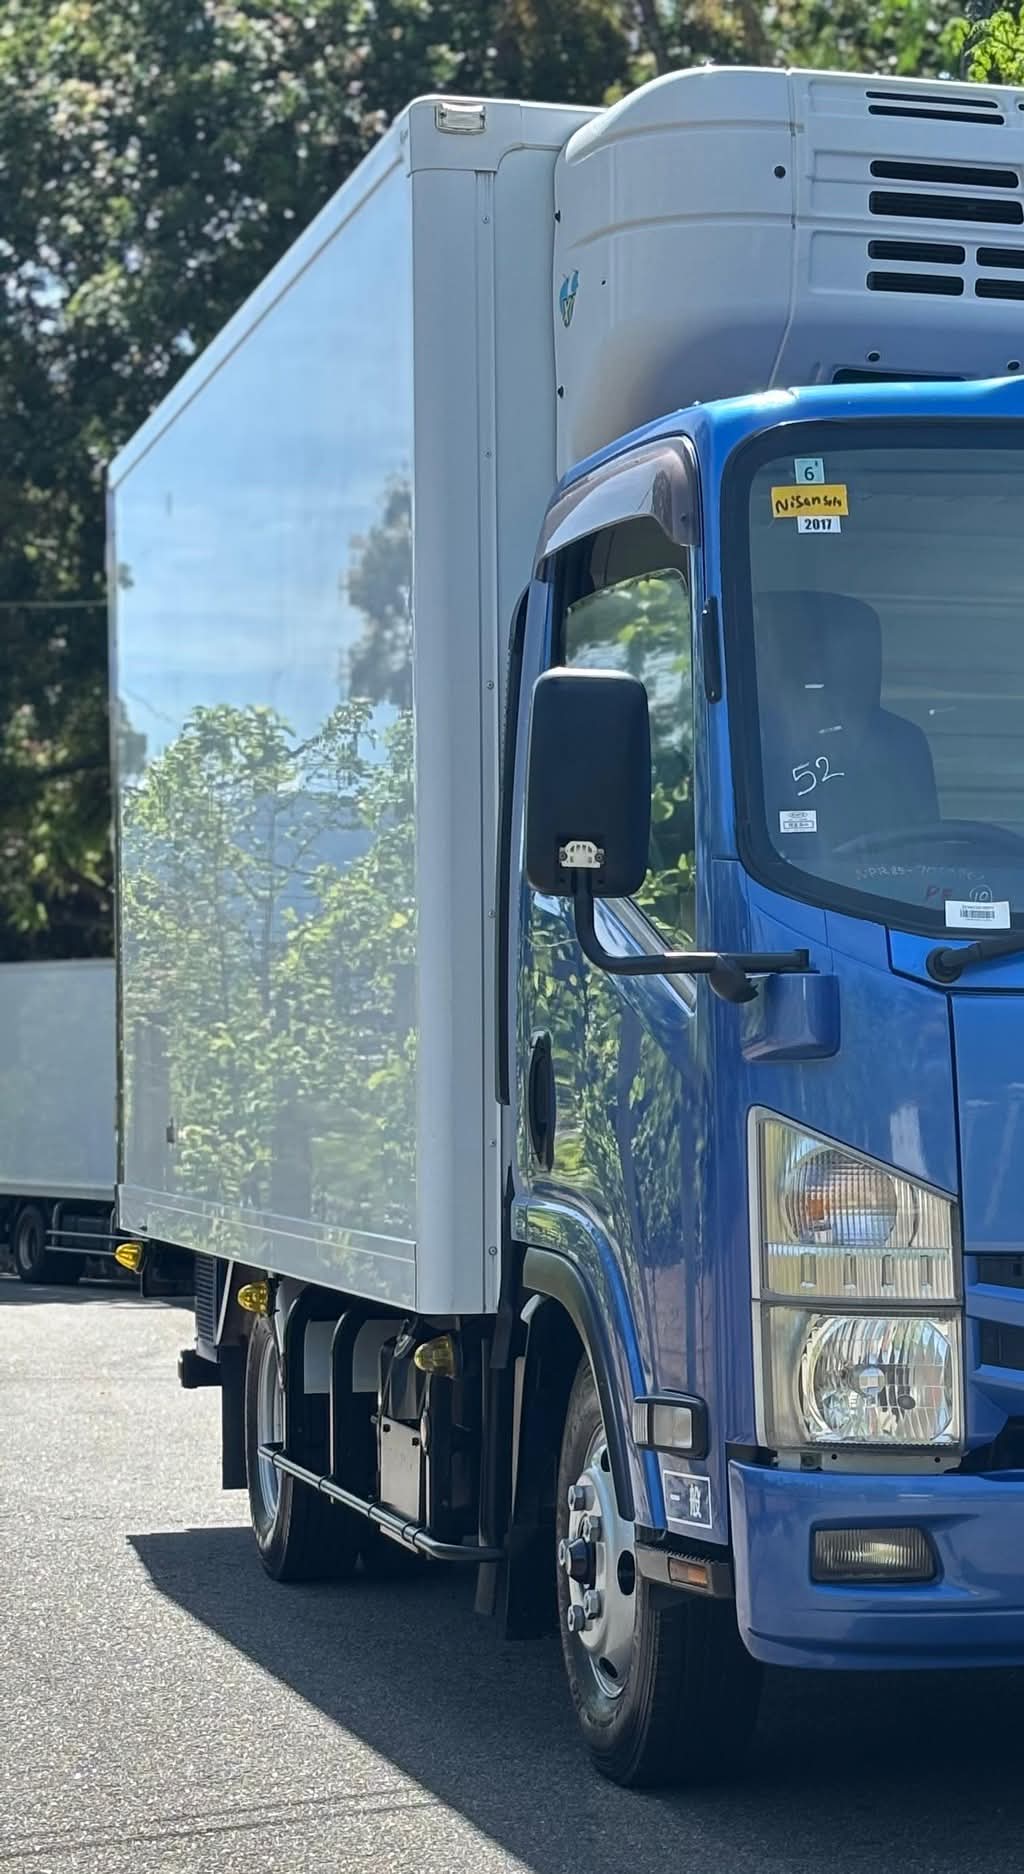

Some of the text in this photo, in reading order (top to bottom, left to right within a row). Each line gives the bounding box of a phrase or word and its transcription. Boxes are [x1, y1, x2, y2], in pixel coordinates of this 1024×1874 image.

[804, 466, 814, 480] 6
[804, 518, 832, 530] 2017
[792, 756, 845, 796] 52
[669, 1483, 702, 1519] 一般
